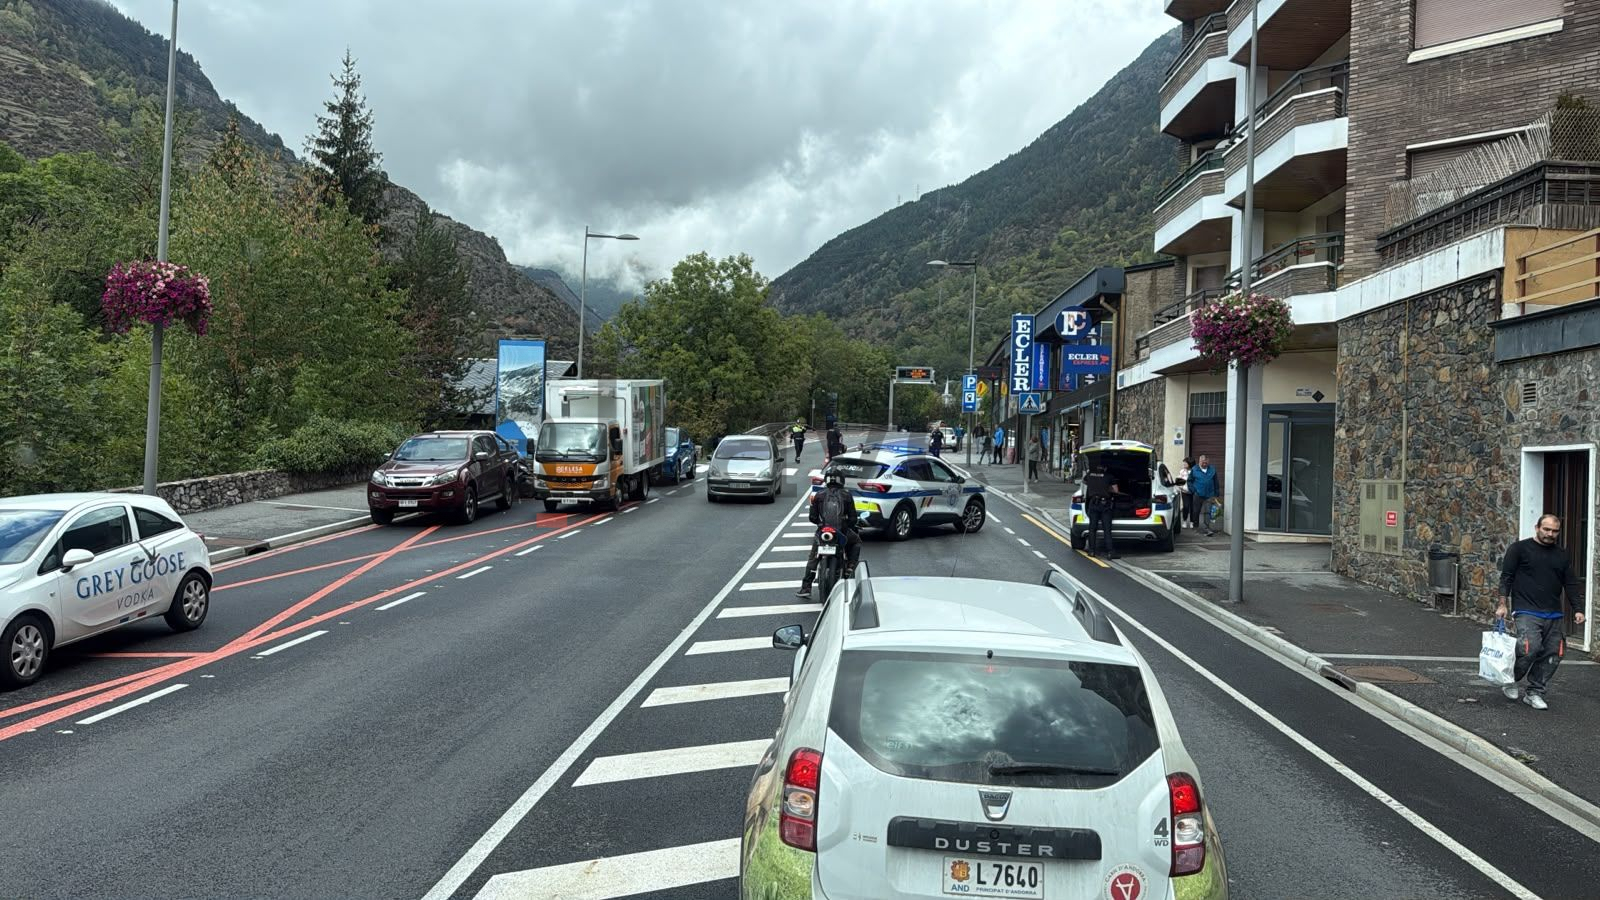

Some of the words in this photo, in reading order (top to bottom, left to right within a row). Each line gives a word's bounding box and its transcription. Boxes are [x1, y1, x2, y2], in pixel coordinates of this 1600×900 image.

[1013, 319, 1031, 392] ECLER
[1068, 353, 1099, 361] ECLER
[966, 377, 976, 389] P
[76, 568, 126, 599] GREY
[131, 552, 186, 584] GOOSE
[116, 588, 154, 610] VODKA
[1154, 817, 1169, 838] 4
[935, 837, 1054, 857] DUSTER
[976, 862, 987, 885] L
[993, 863, 1038, 889] 7640
[951, 884, 970, 892] AND
